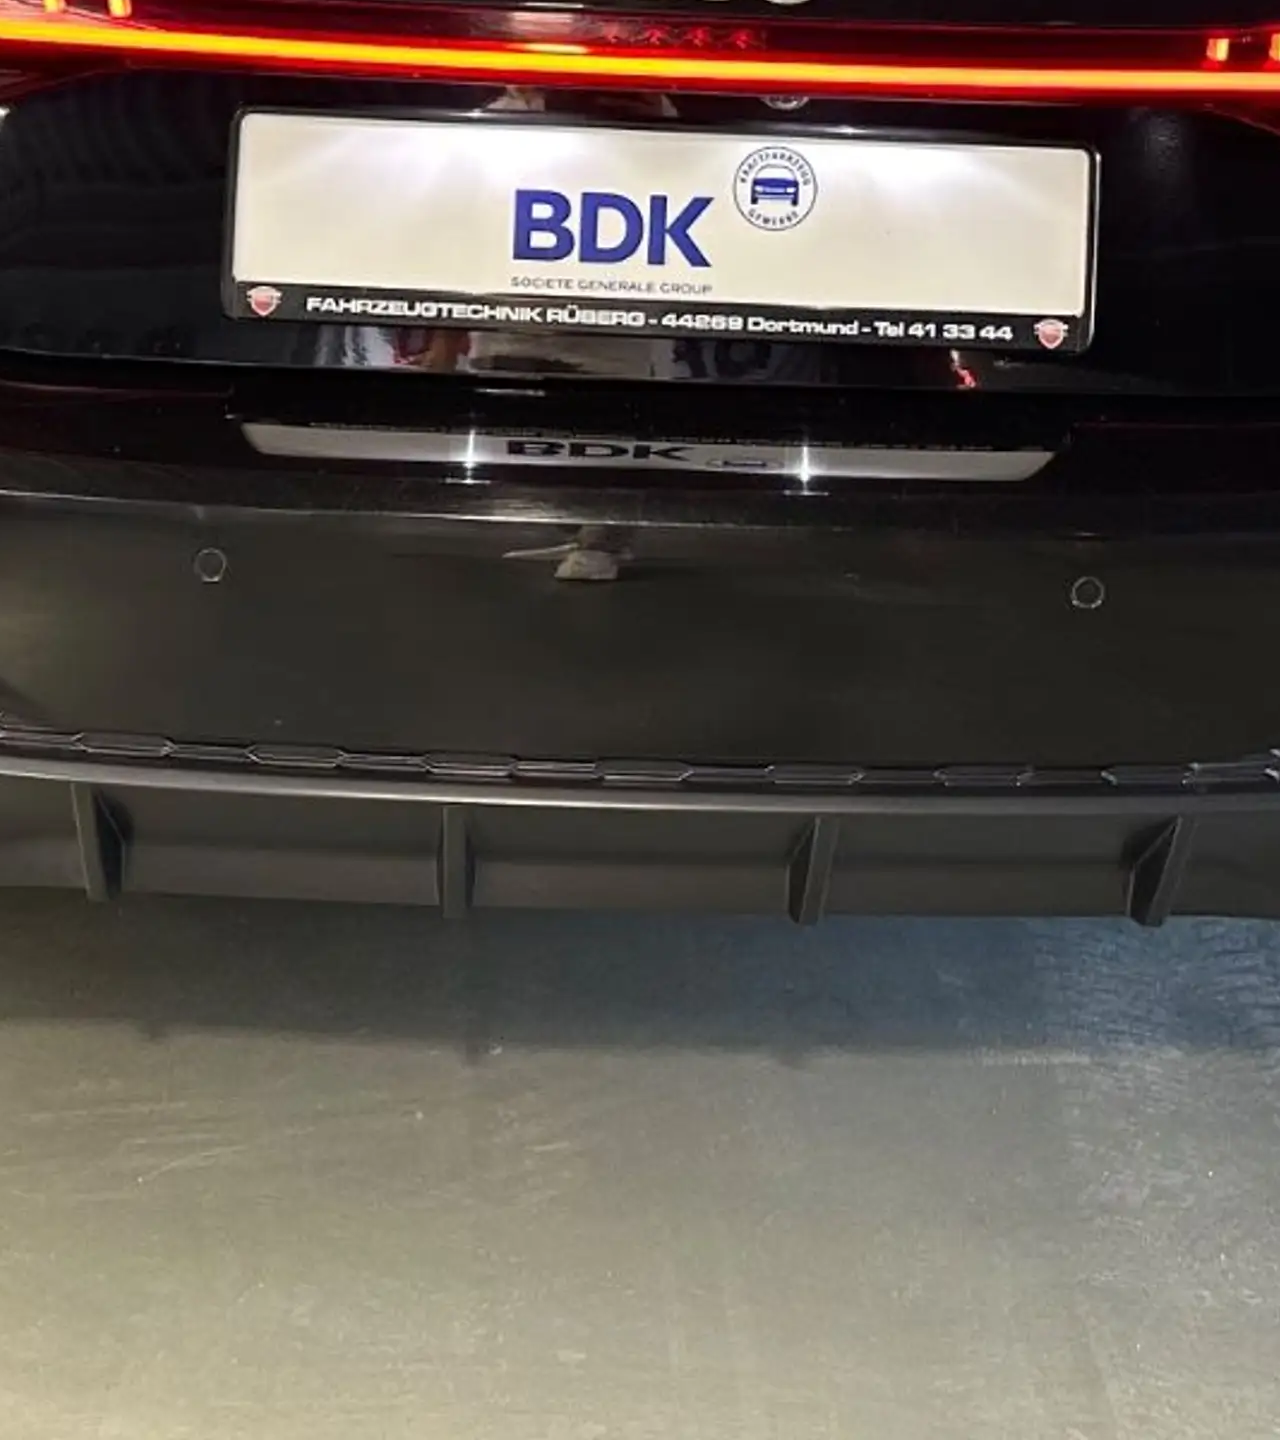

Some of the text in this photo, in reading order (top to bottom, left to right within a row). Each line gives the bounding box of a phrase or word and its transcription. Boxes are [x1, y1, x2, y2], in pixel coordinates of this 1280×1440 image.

[512, 189, 715, 268] BDK
[577, 278, 654, 293] GENERALE
[659, 280, 713, 295] GROUP
[306, 296, 542, 324] FAHRZEUGTECHNIK
[546, 302, 646, 328] RÜBERG
[748, 316, 859, 337] Dortmund
[873, 321, 905, 338] Tel
[909, 323, 937, 339] 41
[942, 323, 974, 341] 33
[979, 325, 1014, 341] 44
